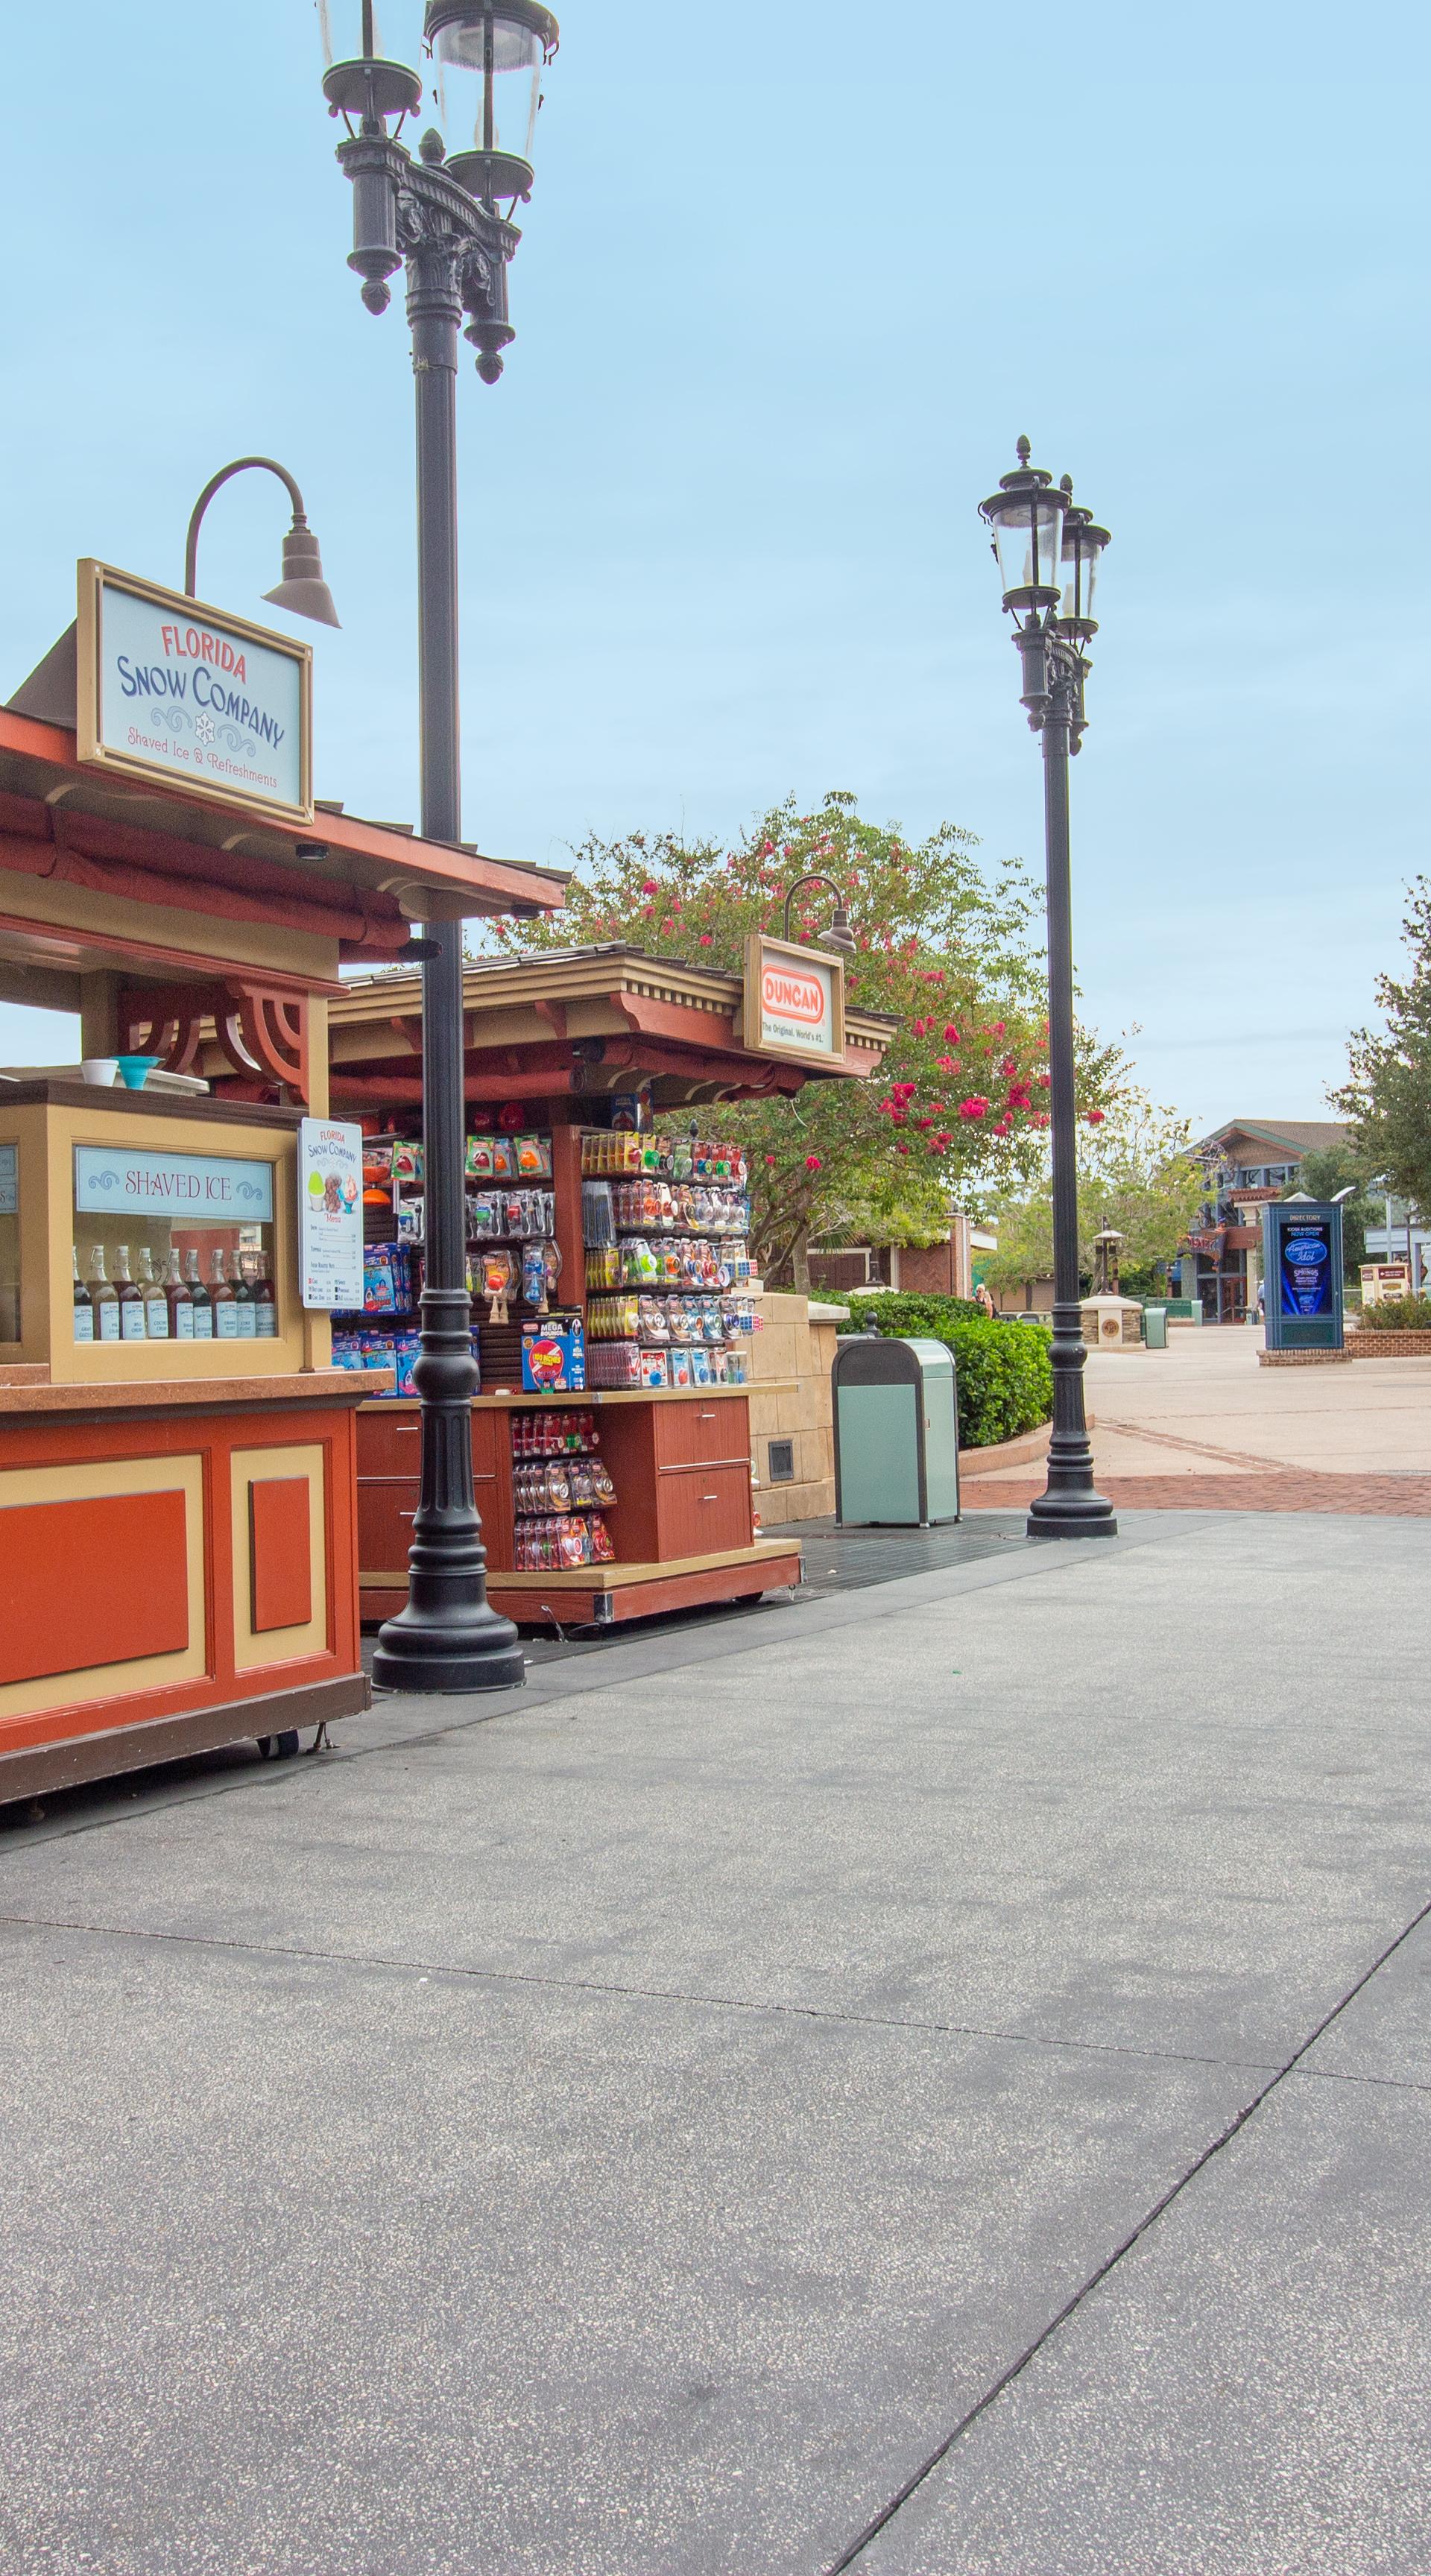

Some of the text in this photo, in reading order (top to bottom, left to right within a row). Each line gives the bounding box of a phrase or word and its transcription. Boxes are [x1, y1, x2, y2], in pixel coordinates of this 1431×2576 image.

[161, 626, 247, 685] FLORIDA
[117, 655, 285, 751] SNOW COMPANY
[127, 727, 278, 789] Shaved Ice & Refreshments
[765, 977, 818, 1012] DUNCAN
[762, 1021, 772, 1032] The
[320, 1130, 345, 1144] FLORIDA
[308, 1141, 357, 1164] SNOW COMPANY
[125, 1170, 232, 1200] SHAVED ICE
[1296, 1251, 1315, 1261] Idol
[540, 1324, 563, 1332] MEGA
